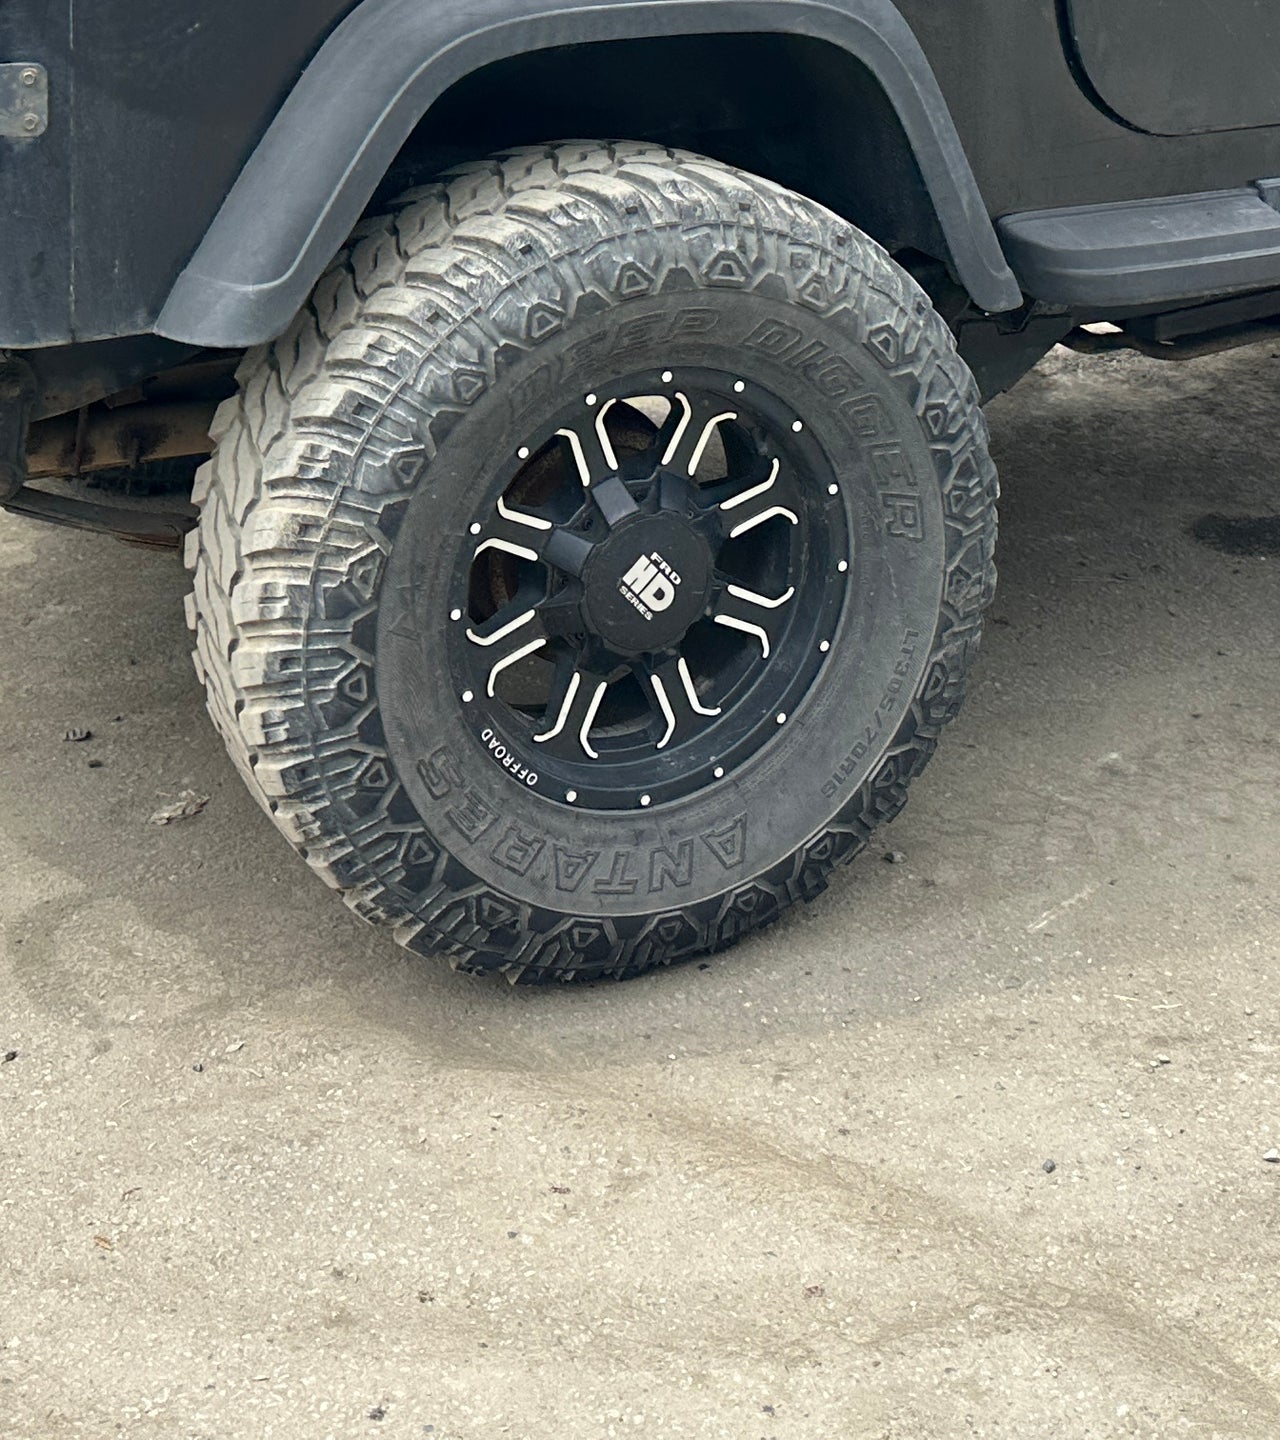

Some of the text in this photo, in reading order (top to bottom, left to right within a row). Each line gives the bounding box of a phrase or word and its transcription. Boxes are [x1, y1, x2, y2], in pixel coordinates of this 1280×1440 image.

[743, 318, 926, 544] DIGGER
[619, 585, 654, 621] SERIES
[622, 554, 675, 612] HD
[481, 728, 538, 786] OFFROAD
[416, 744, 749, 897] ANTARES
